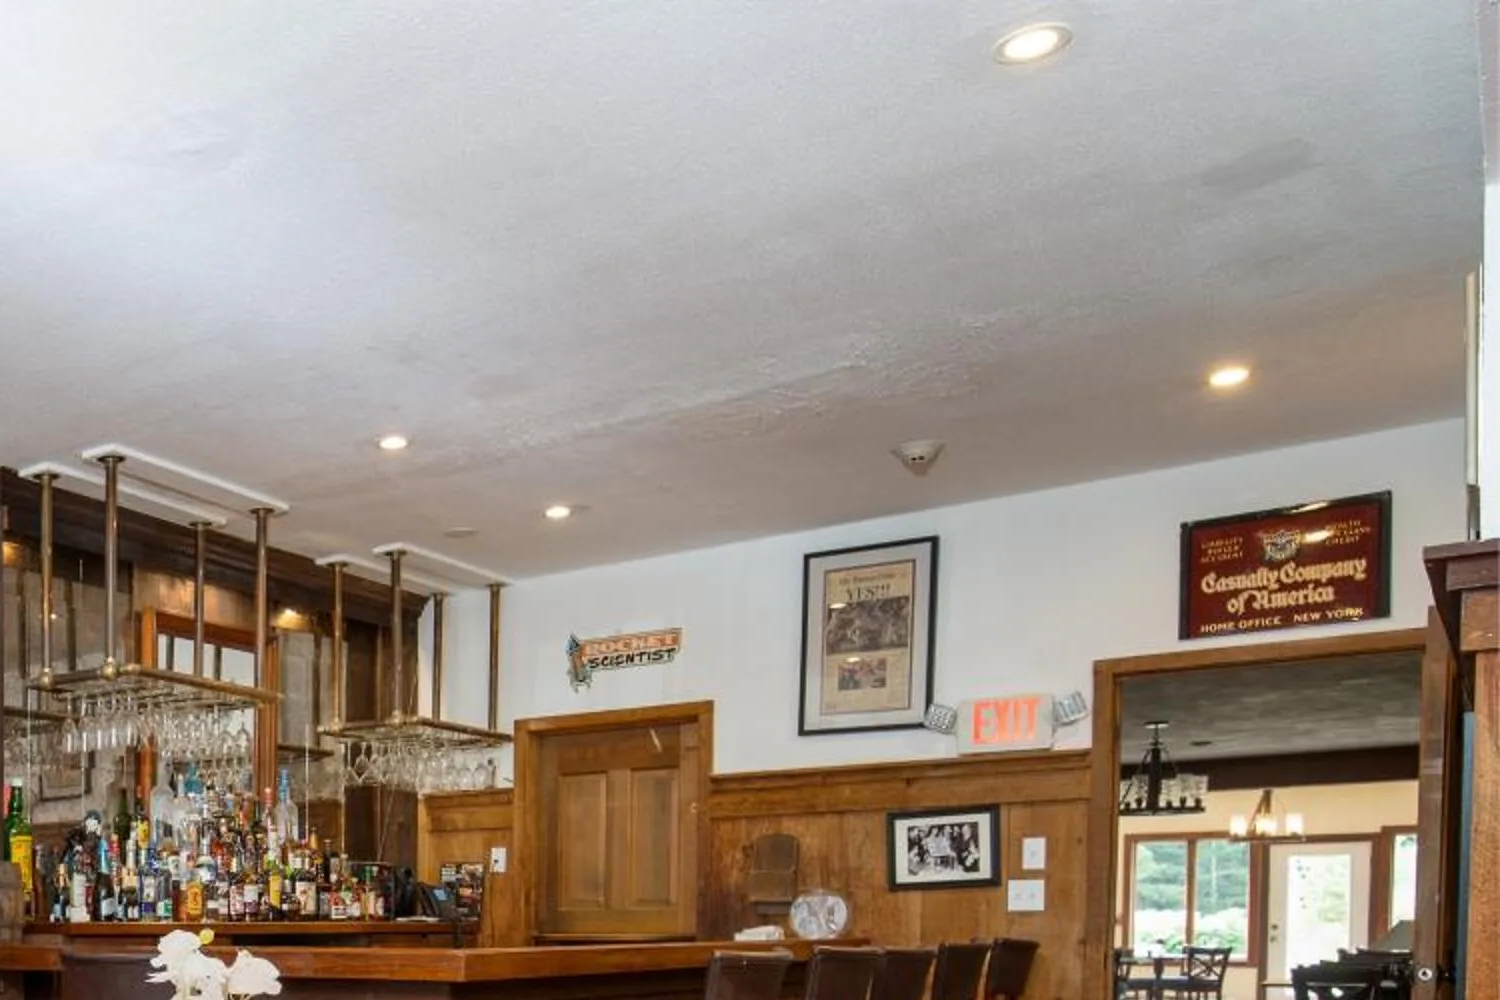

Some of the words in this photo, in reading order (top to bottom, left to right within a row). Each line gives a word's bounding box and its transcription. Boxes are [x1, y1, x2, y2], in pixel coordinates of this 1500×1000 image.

[1280, 558, 1367, 584] Company
[1227, 591, 1248, 615] of
[1247, 583, 1335, 611] America
[1200, 621, 1235, 634] HOME
[1239, 615, 1282, 630] OFFICE
[1293, 610, 1321, 623] NEW
[1326, 607, 1365, 621] YORK
[588, 647, 677, 669] SCIENTIST
[973, 697, 1041, 744] EXIT
